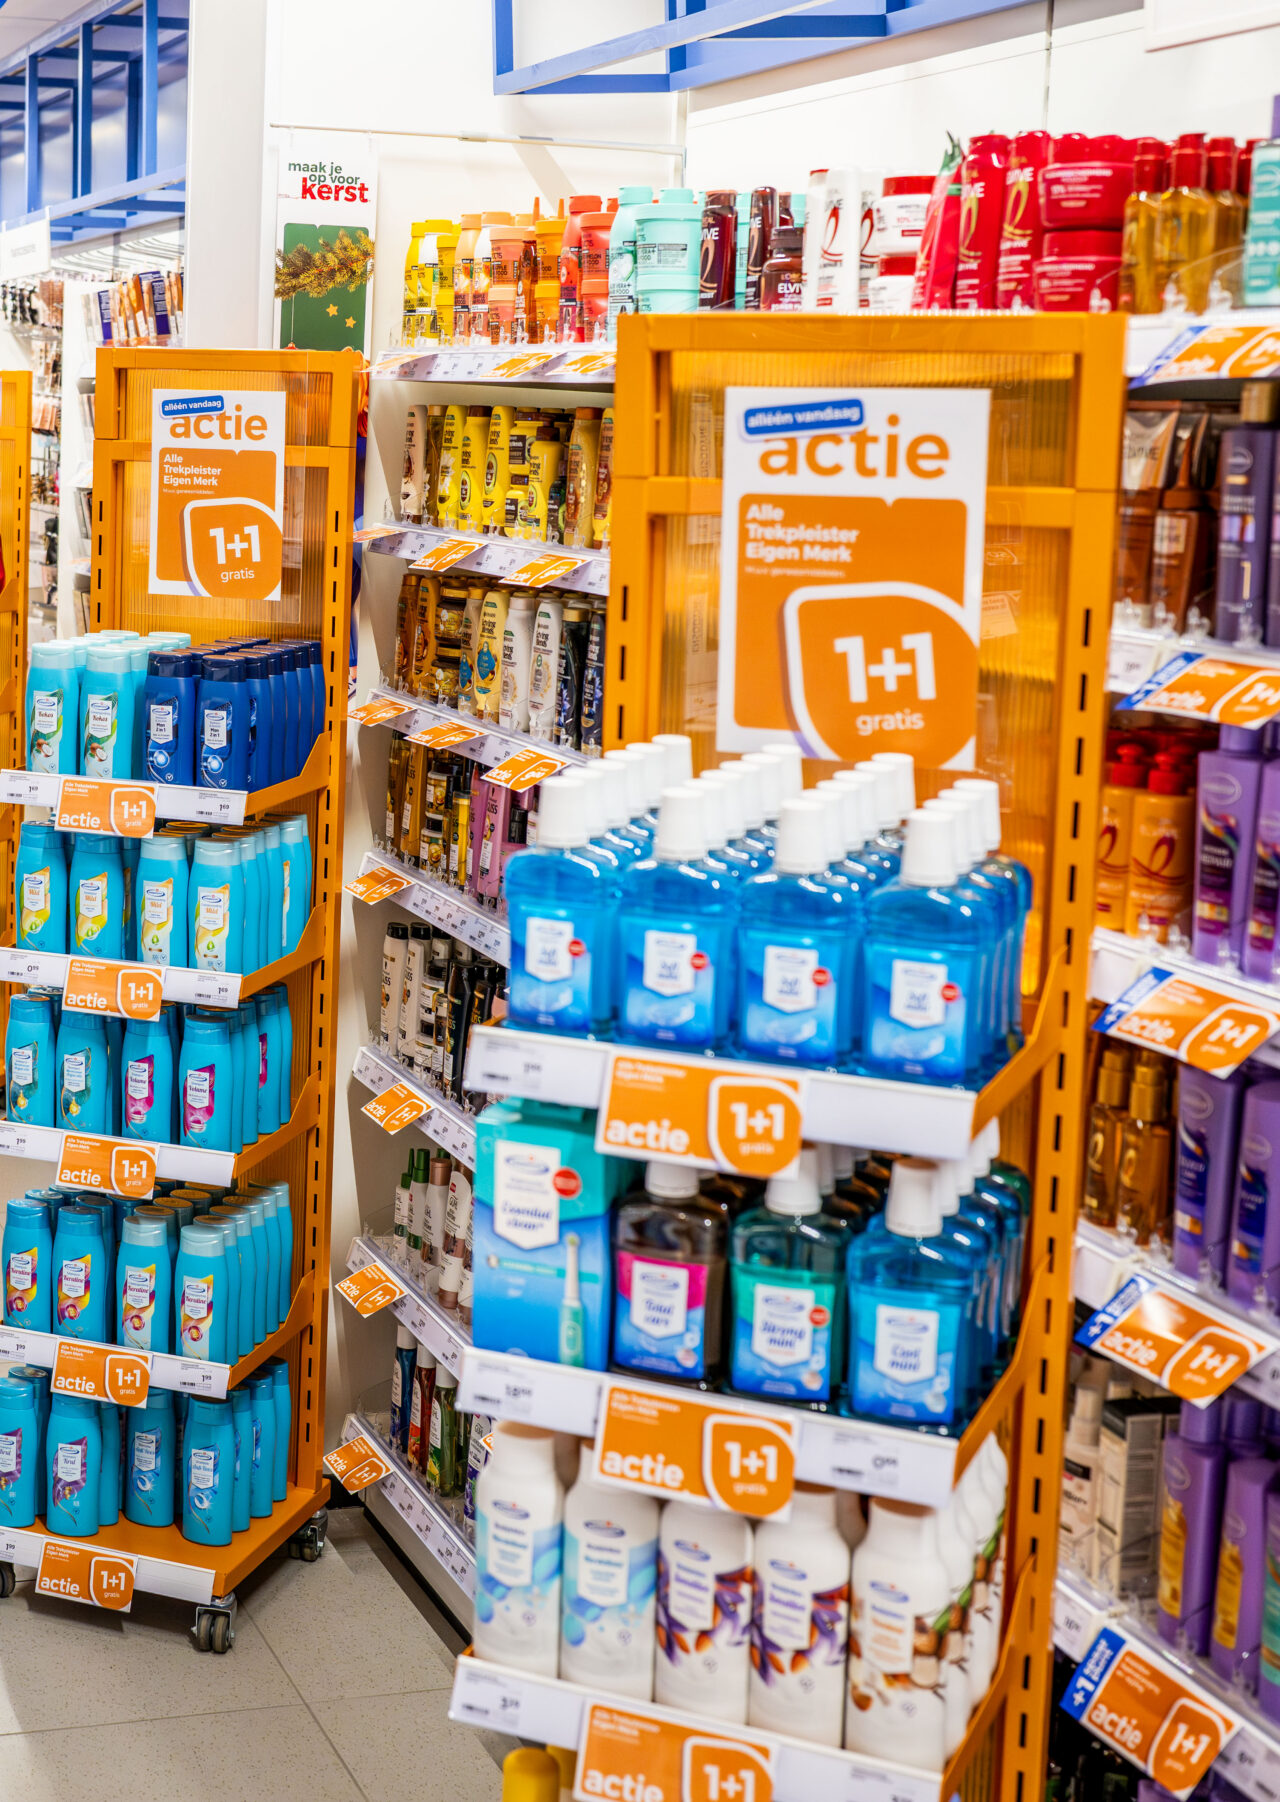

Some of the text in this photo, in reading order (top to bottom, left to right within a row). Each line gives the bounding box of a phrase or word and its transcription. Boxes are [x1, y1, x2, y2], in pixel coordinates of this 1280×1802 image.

[288, 162, 342, 176] maak je
[309, 174, 360, 185] op voor
[302, 177, 368, 203] kerst
[165, 399, 222, 411] alléén vandaag
[170, 404, 267, 441] actie
[748, 404, 860, 428] alléén vandaag
[758, 414, 950, 479] actie
[164, 454, 183, 463] Alle
[164, 465, 222, 476] Trekpleister
[164, 476, 218, 486] Eigen Merk
[746, 504, 784, 522] Alle
[747, 524, 859, 543] Trekpleister
[209, 525, 261, 564] 1+1
[746, 543, 852, 563] Eigen Merk
[221, 568, 255, 582] gratis
[834, 632, 936, 703] 1+1
[856, 710, 924, 735] gratis
[121, 800, 146, 819] 1+1
[60, 812, 100, 828] actie
[67, 992, 107, 1008] actie
[128, 983, 153, 1000] 1+1
[1121, 1014, 1176, 1044] actie
[1207, 1018, 1260, 1048] 1+1
[366, 1102, 386, 1118] actie
[395, 1107, 419, 1122] 1+1
[730, 1102, 785, 1140] 1+1
[606, 1118, 689, 1152] actie
[61, 1169, 101, 1185] actie
[122, 1160, 147, 1178] 1+1
[340, 1280, 360, 1298] actie
[369, 1290, 390, 1305] 1+1
[1104, 1330, 1158, 1366] actie
[1189, 1345, 1239, 1379] 1+1
[56, 1376, 95, 1393] actie
[116, 1368, 141, 1387] 1+1
[326, 1452, 347, 1472] actie
[601, 1449, 685, 1490] actie
[724, 1441, 778, 1482] 1+1
[355, 1465, 372, 1484] 1+1
[41, 1576, 79, 1595] actie
[101, 1570, 126, 1590] 1+1
[1090, 1703, 1142, 1749] actie
[1170, 1723, 1211, 1764] 1+1
[583, 1768, 663, 1802] actie
[703, 1765, 755, 1802] 1+1
